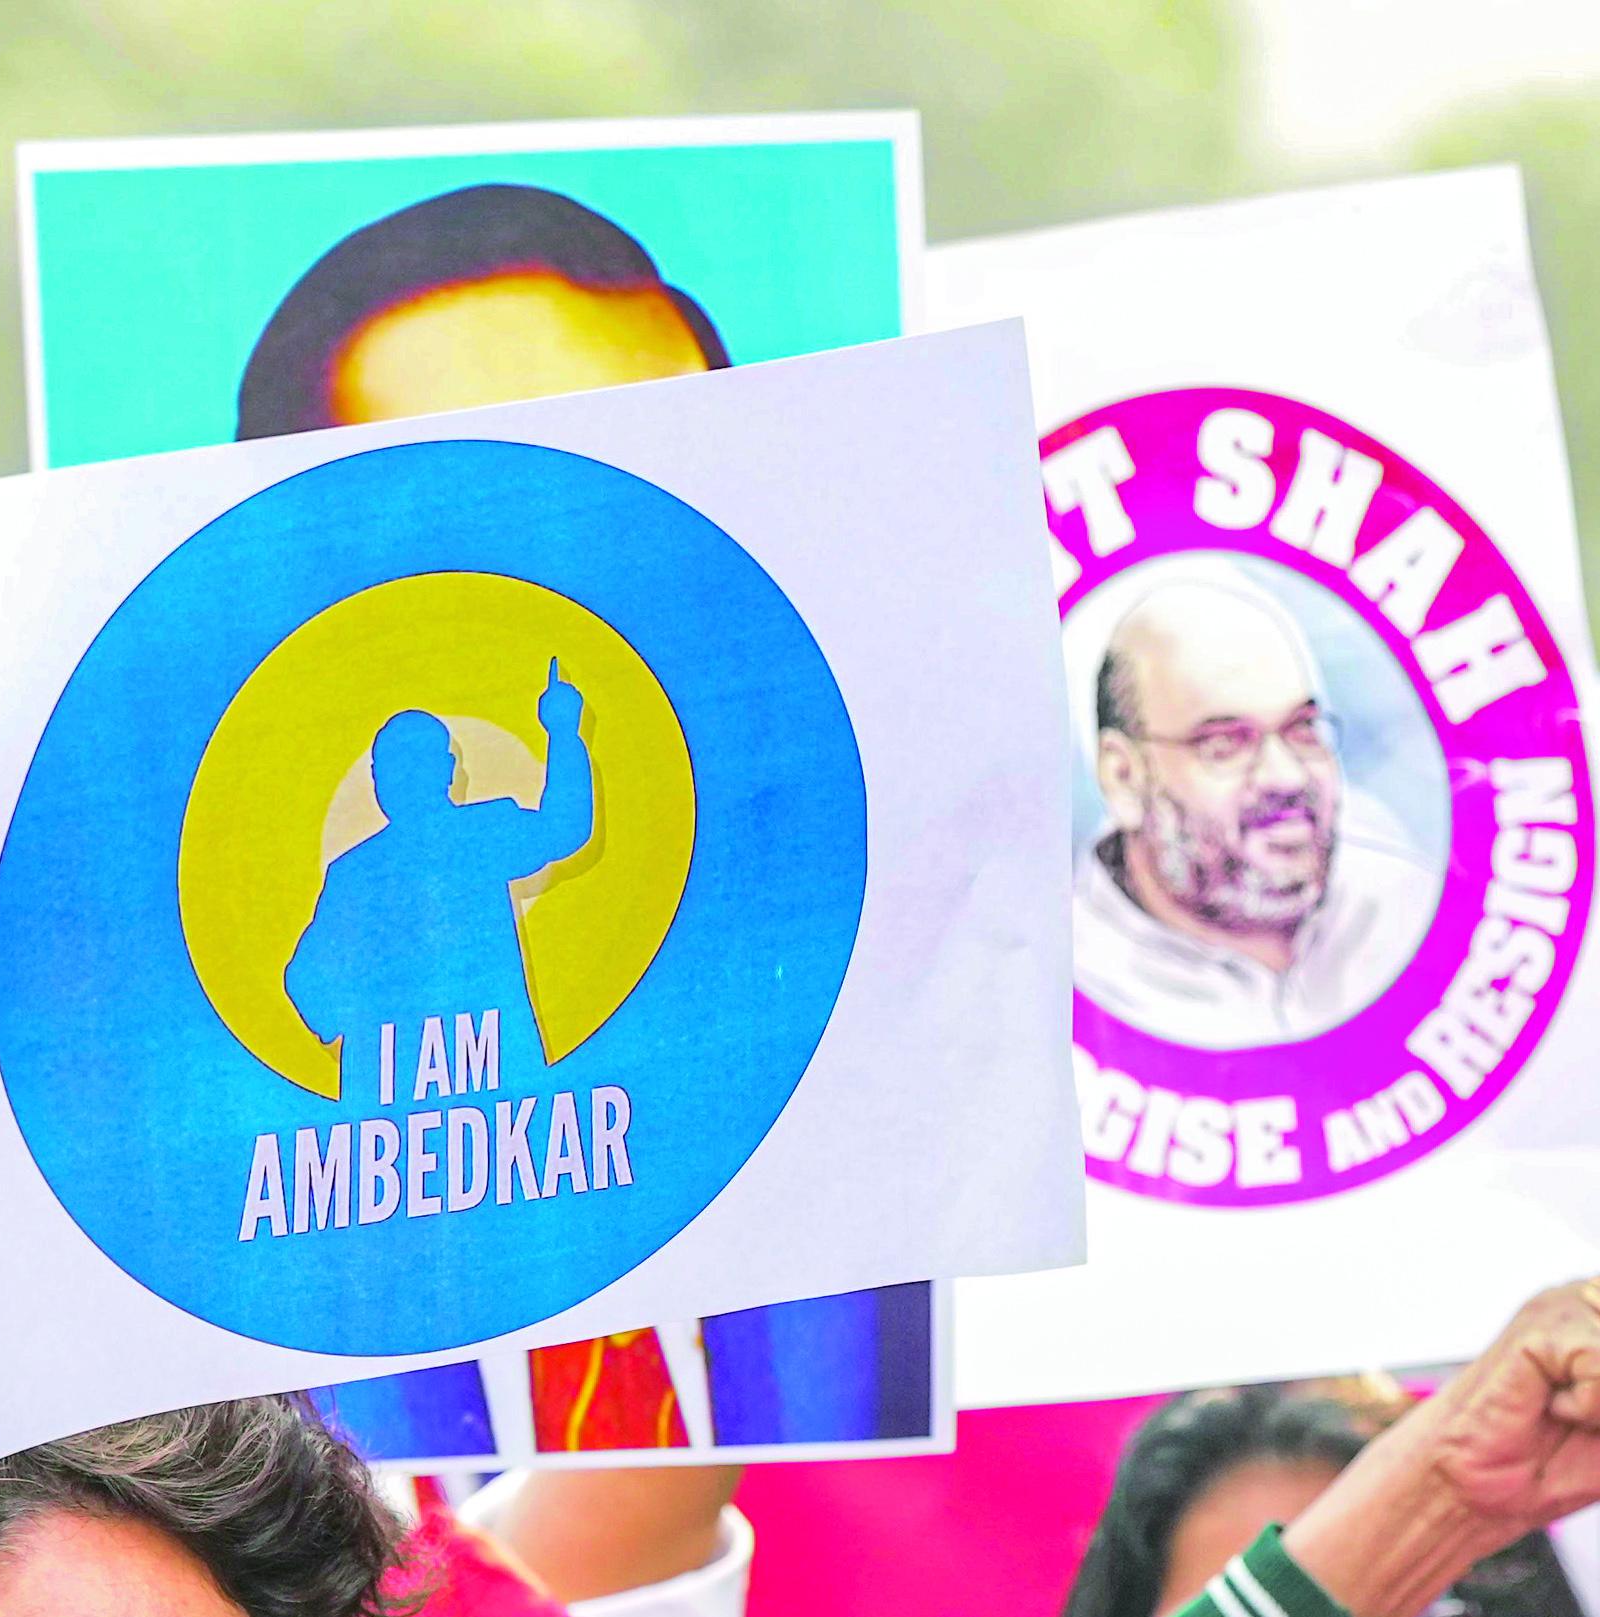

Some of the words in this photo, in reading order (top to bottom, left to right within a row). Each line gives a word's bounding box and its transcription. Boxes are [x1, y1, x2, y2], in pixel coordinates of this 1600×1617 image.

[1041, 424, 1137, 601] T
[1193, 407, 1548, 726] SHAH
[378, 1022, 396, 1106] I
[412, 1008, 500, 1101] AM
[1321, 1080, 1447, 1173] AND
[1405, 755, 1579, 1101] RESIGN
[237, 1084, 634, 1242] AMBEDKAR
